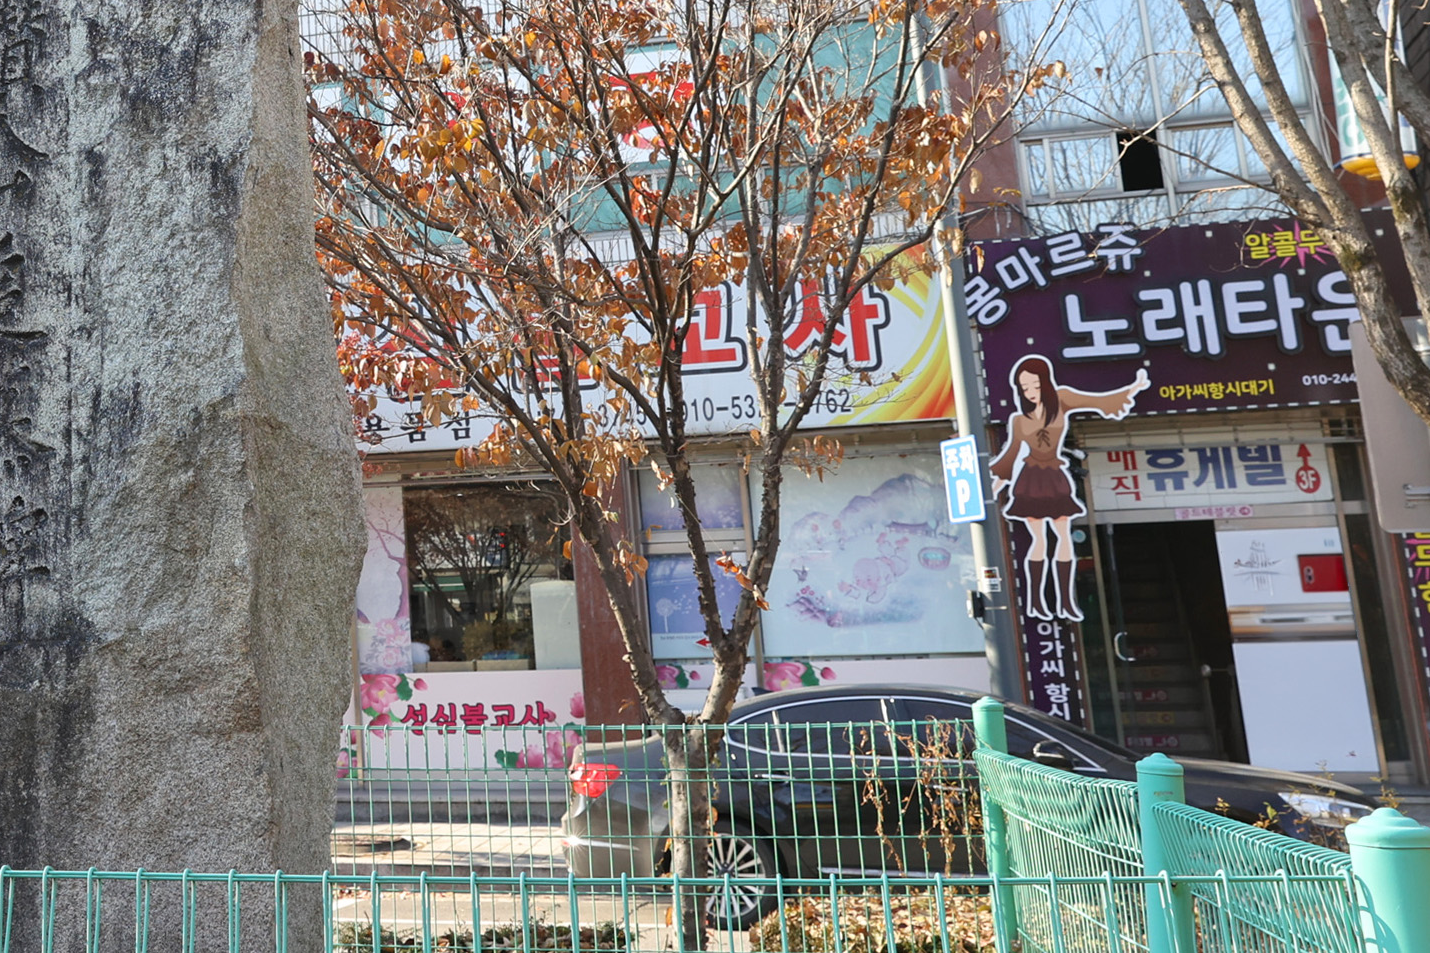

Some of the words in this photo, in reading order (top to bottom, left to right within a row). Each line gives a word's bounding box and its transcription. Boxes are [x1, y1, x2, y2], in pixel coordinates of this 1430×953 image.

[1061, 272, 1361, 358] 노래타운
[1160, 378, 1275, 401] 아가씨항시대기
[945, 444, 975, 477] 주차
[955, 479, 971, 515] P
[1298, 470, 1317, 490] 3F
[1037, 621, 1065, 678] 아가씨
[401, 700, 550, 735] 성심불교사
